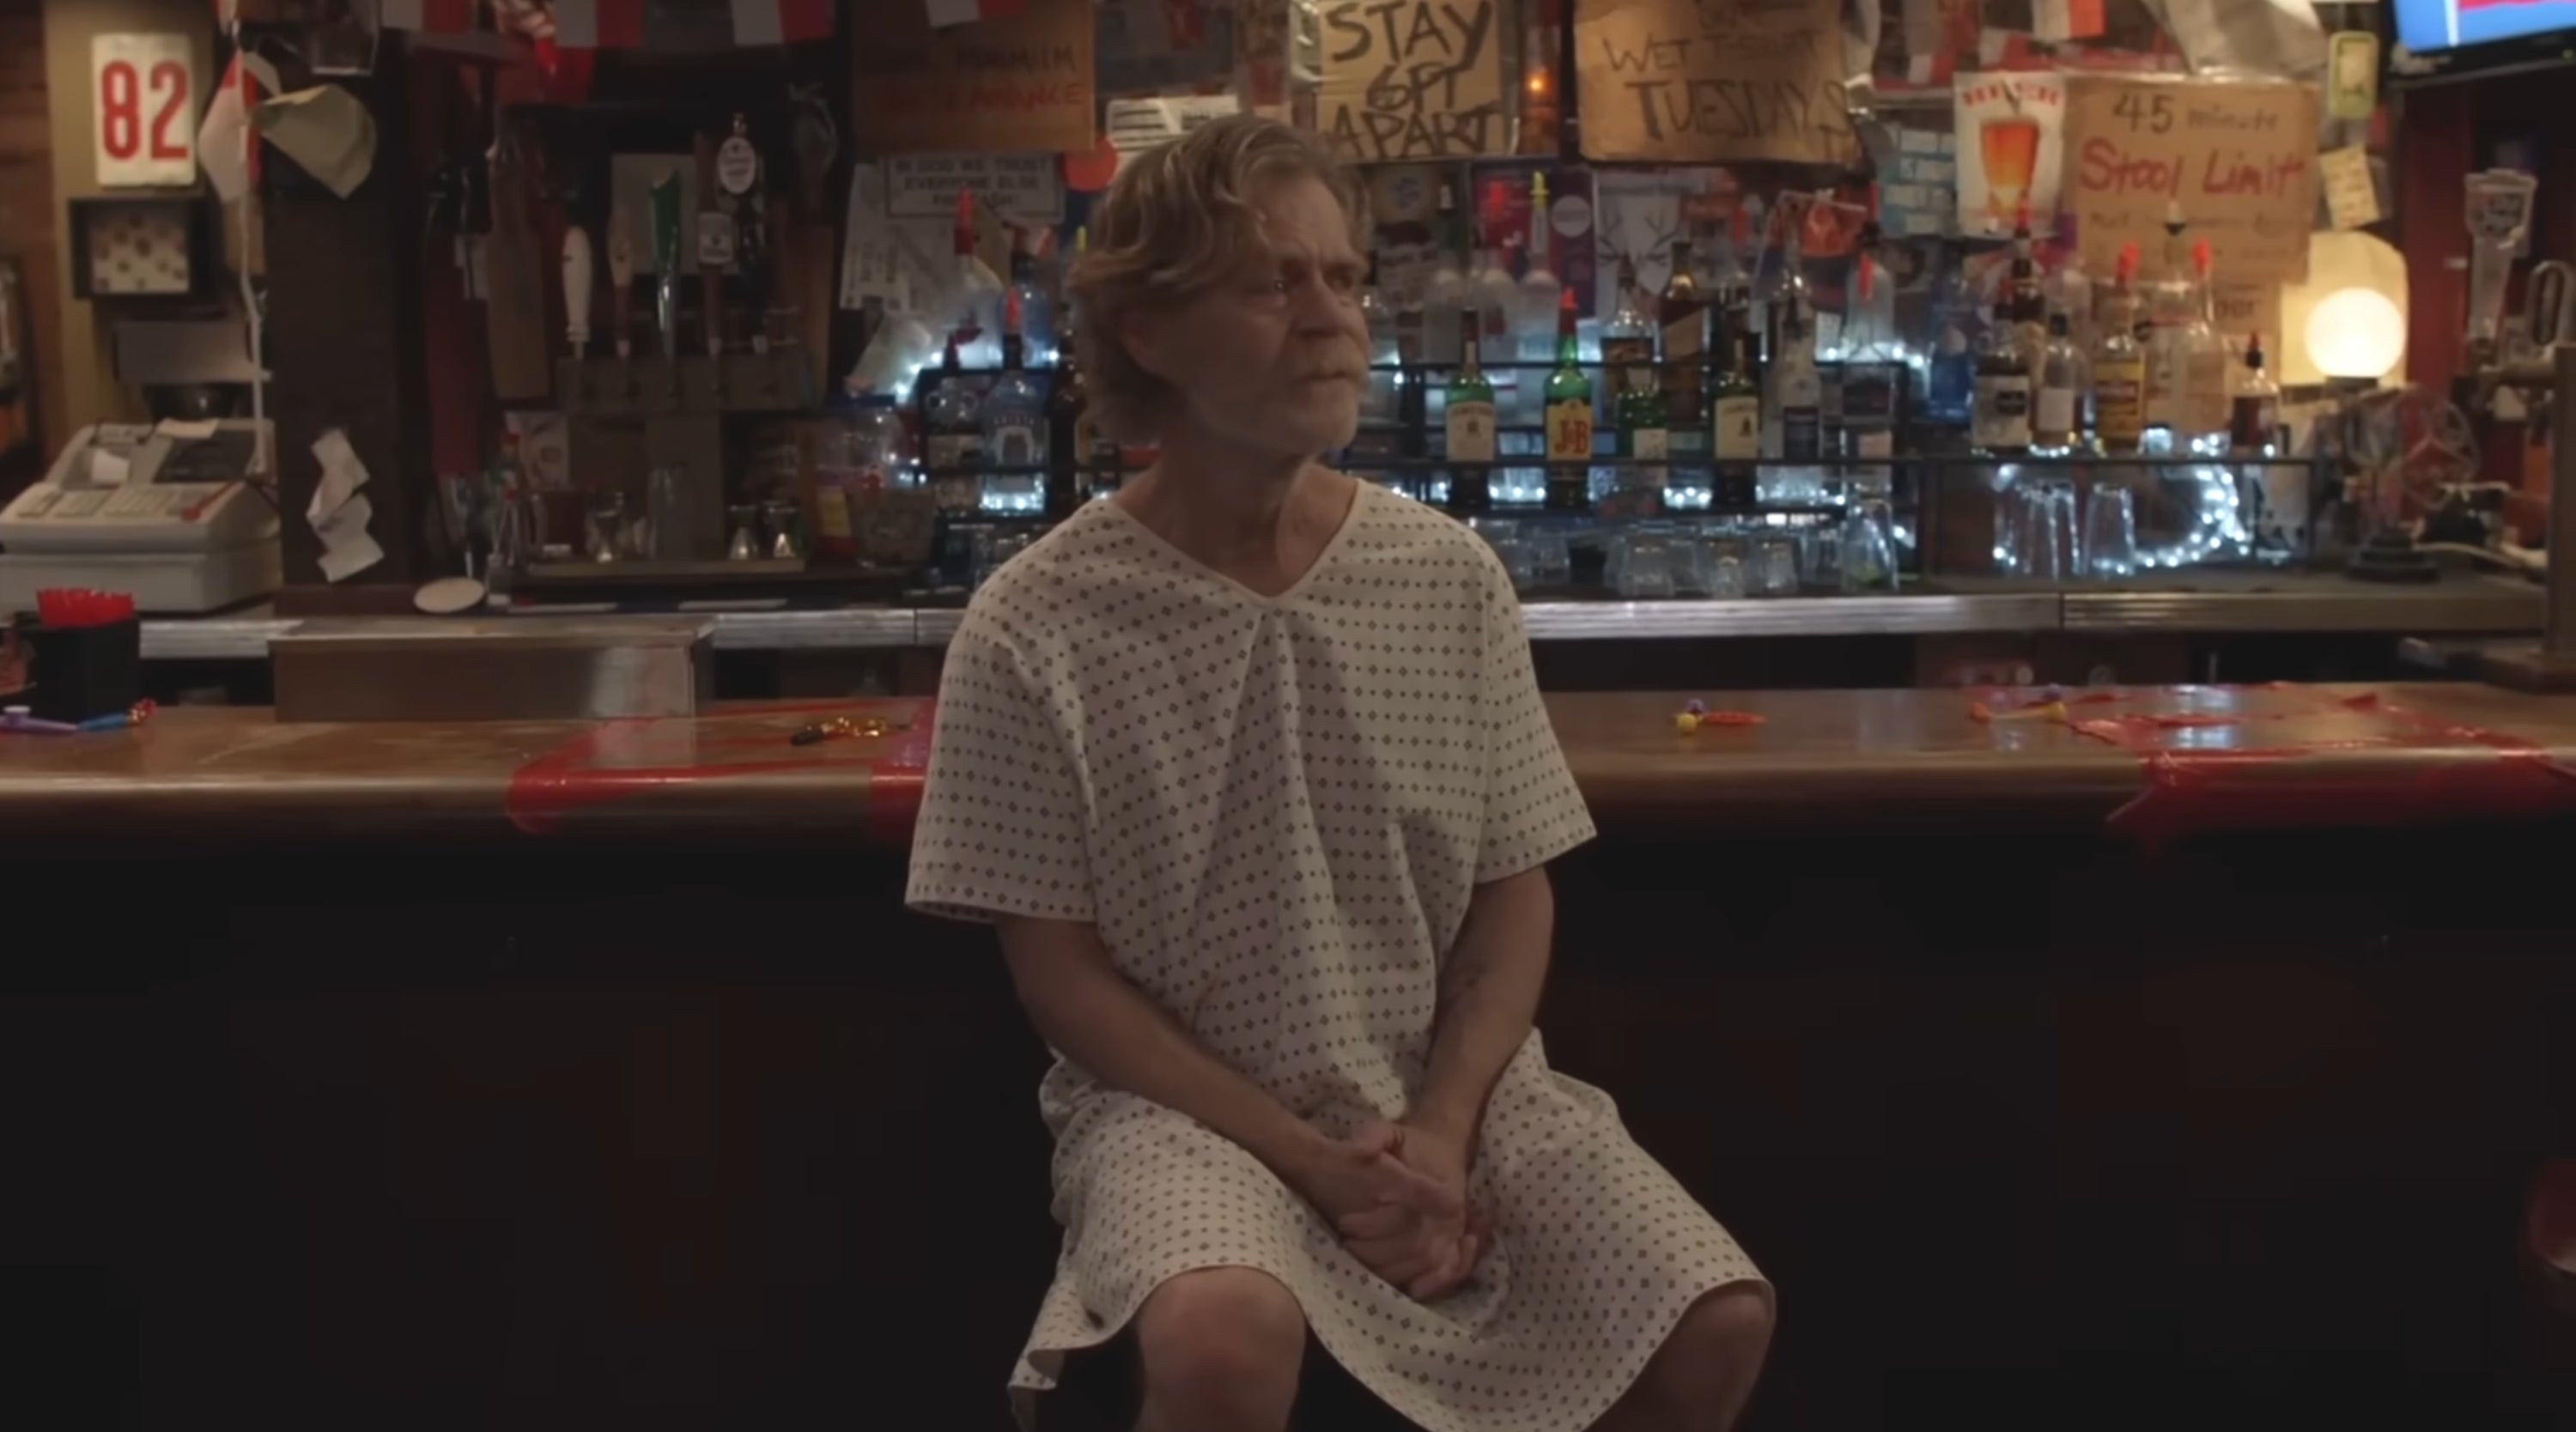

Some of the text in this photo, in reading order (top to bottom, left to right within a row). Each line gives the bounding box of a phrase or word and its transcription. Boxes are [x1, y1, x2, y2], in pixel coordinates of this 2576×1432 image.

[1325, 1, 1492, 70] STAY
[1601, 33, 1691, 72] WET
[102, 60, 188, 161] 82
[1323, 100, 1502, 159] APART
[1623, 78, 1852, 140] TUESDAYS
[2113, 93, 2278, 133] 45 minute
[2080, 137, 2184, 197] Stool
[1554, 419, 1589, 454] J&B
